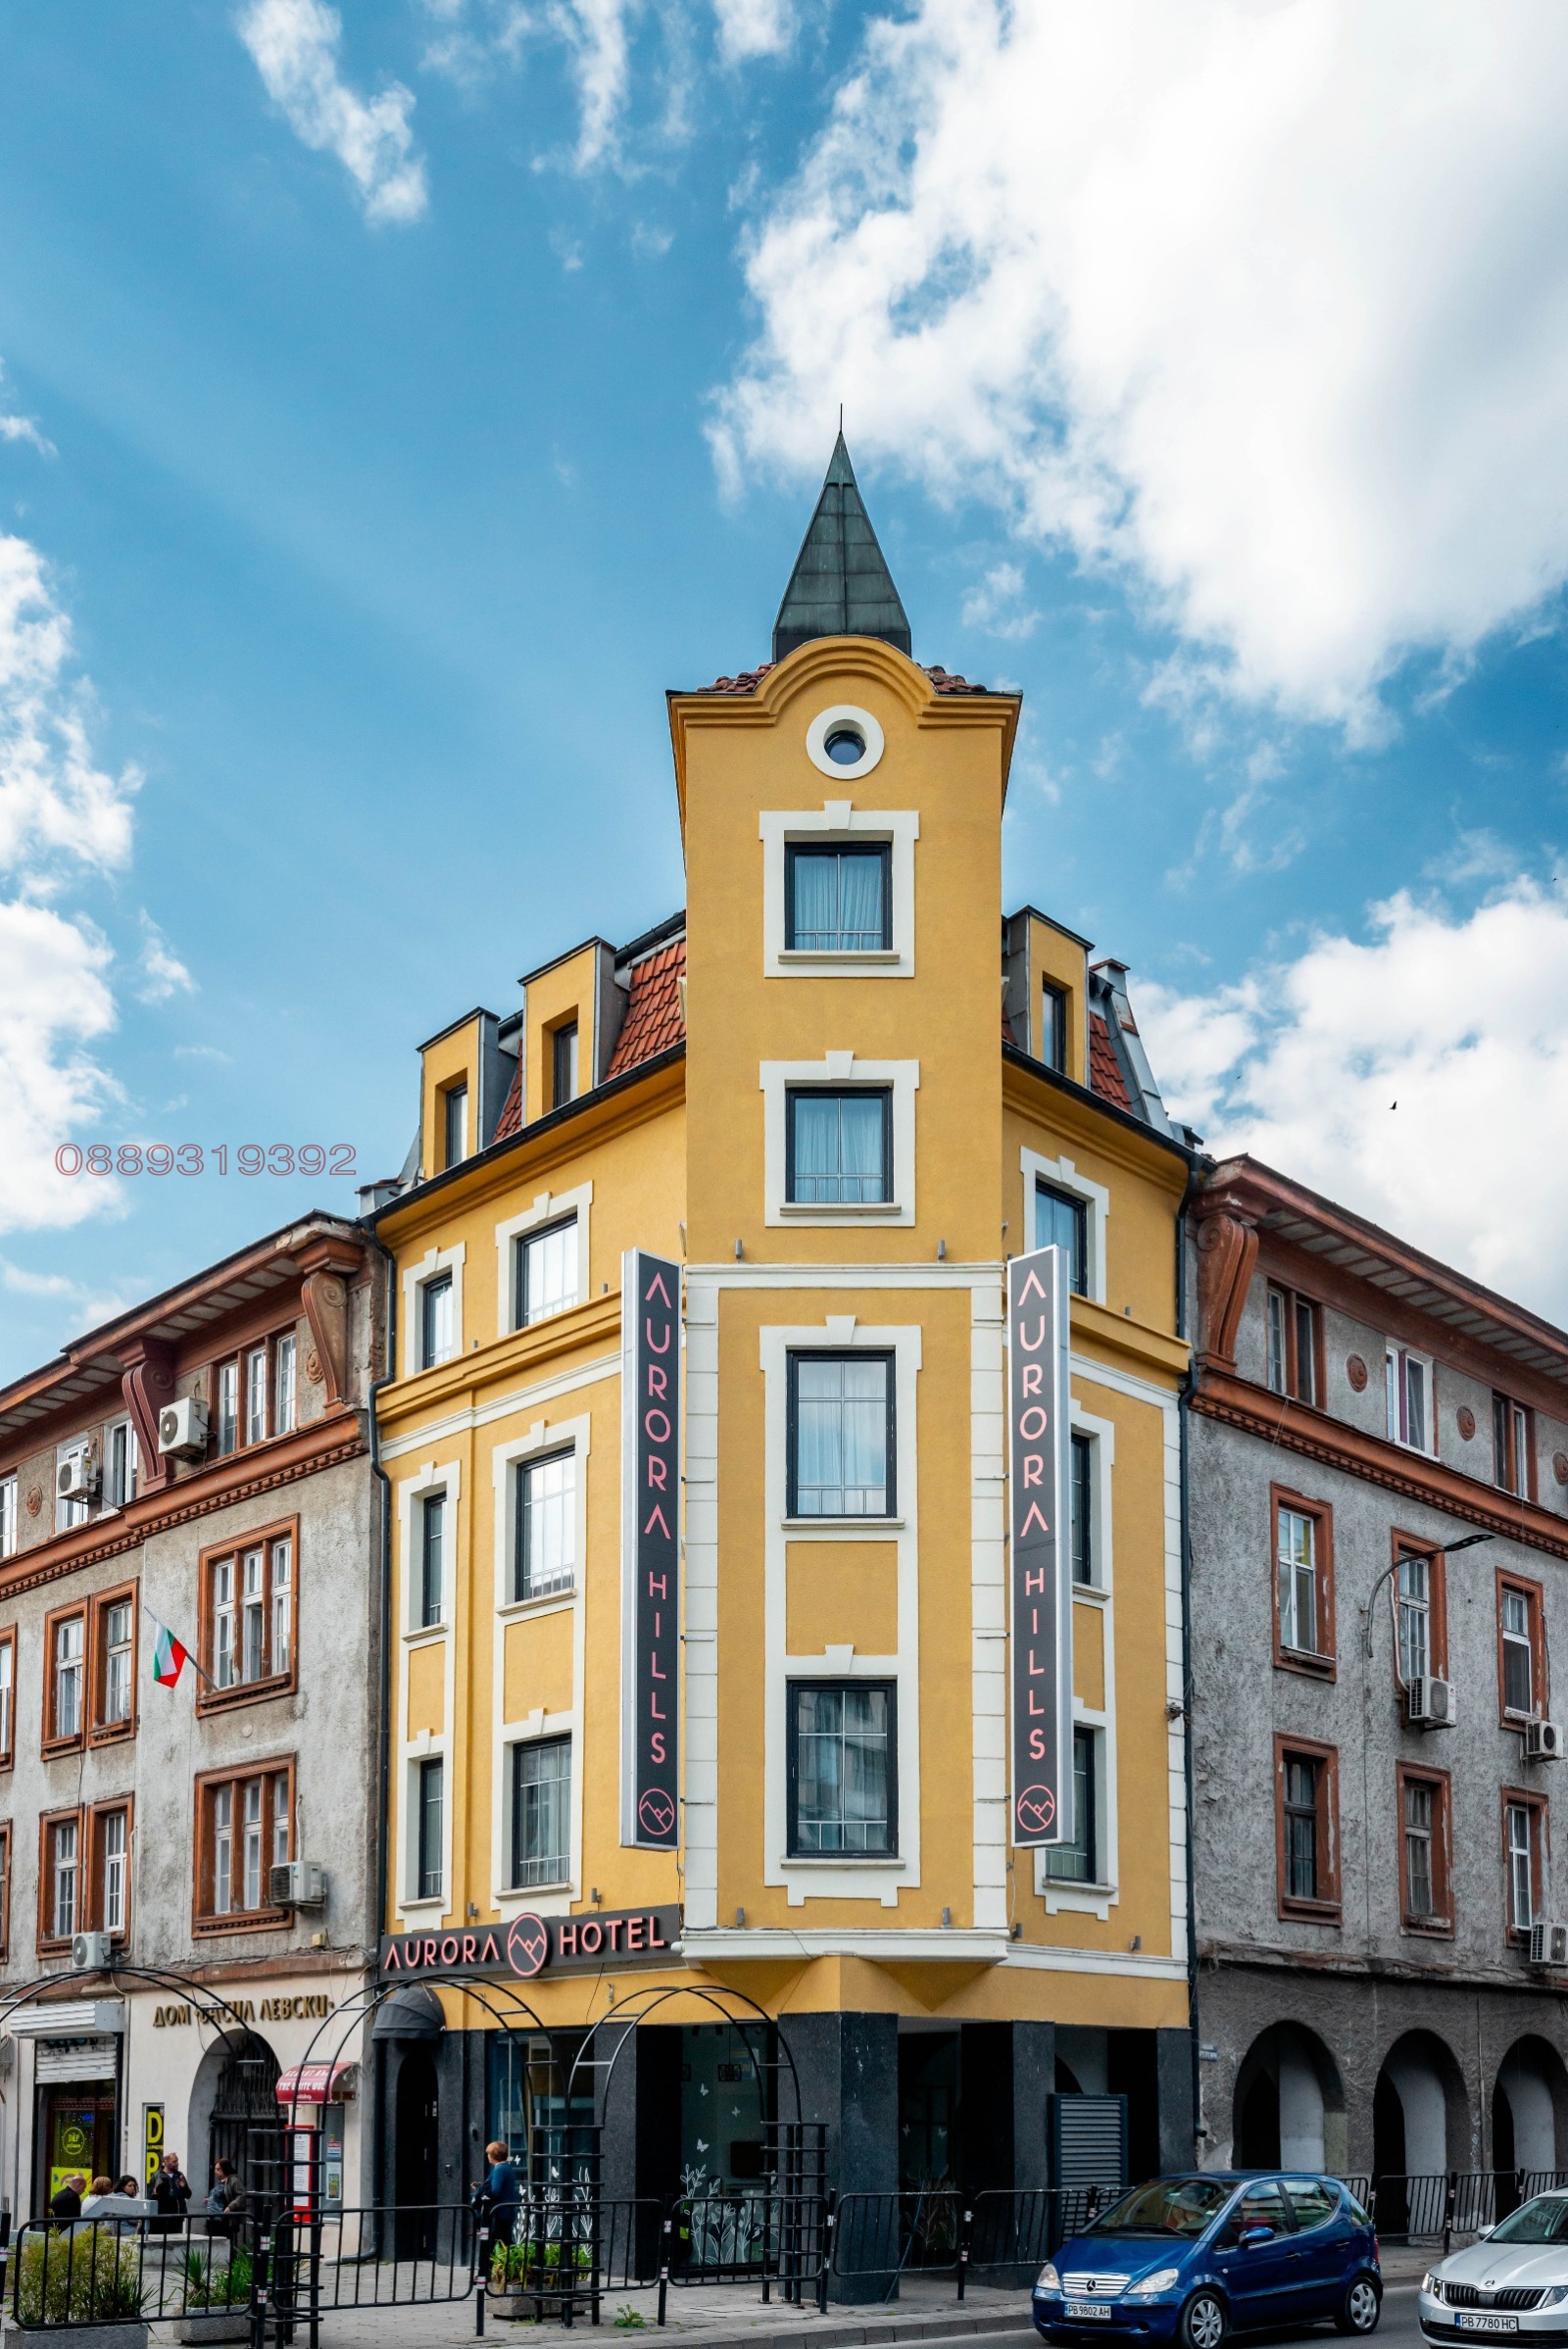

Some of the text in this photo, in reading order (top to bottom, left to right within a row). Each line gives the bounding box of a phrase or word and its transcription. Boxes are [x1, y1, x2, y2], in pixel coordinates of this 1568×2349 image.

[645, 1271, 671, 1764] AURORA HILLS
[1017, 1268, 1050, 1761] AURORA HILLS
[384, 1916, 665, 1971] AURORA HOTEL
[153, 2003, 191, 2028] ДОМ
[1068, 2305, 1110, 2317] PB 9802 AH
[1461, 2317, 1516, 2329] PB 7780 HC
